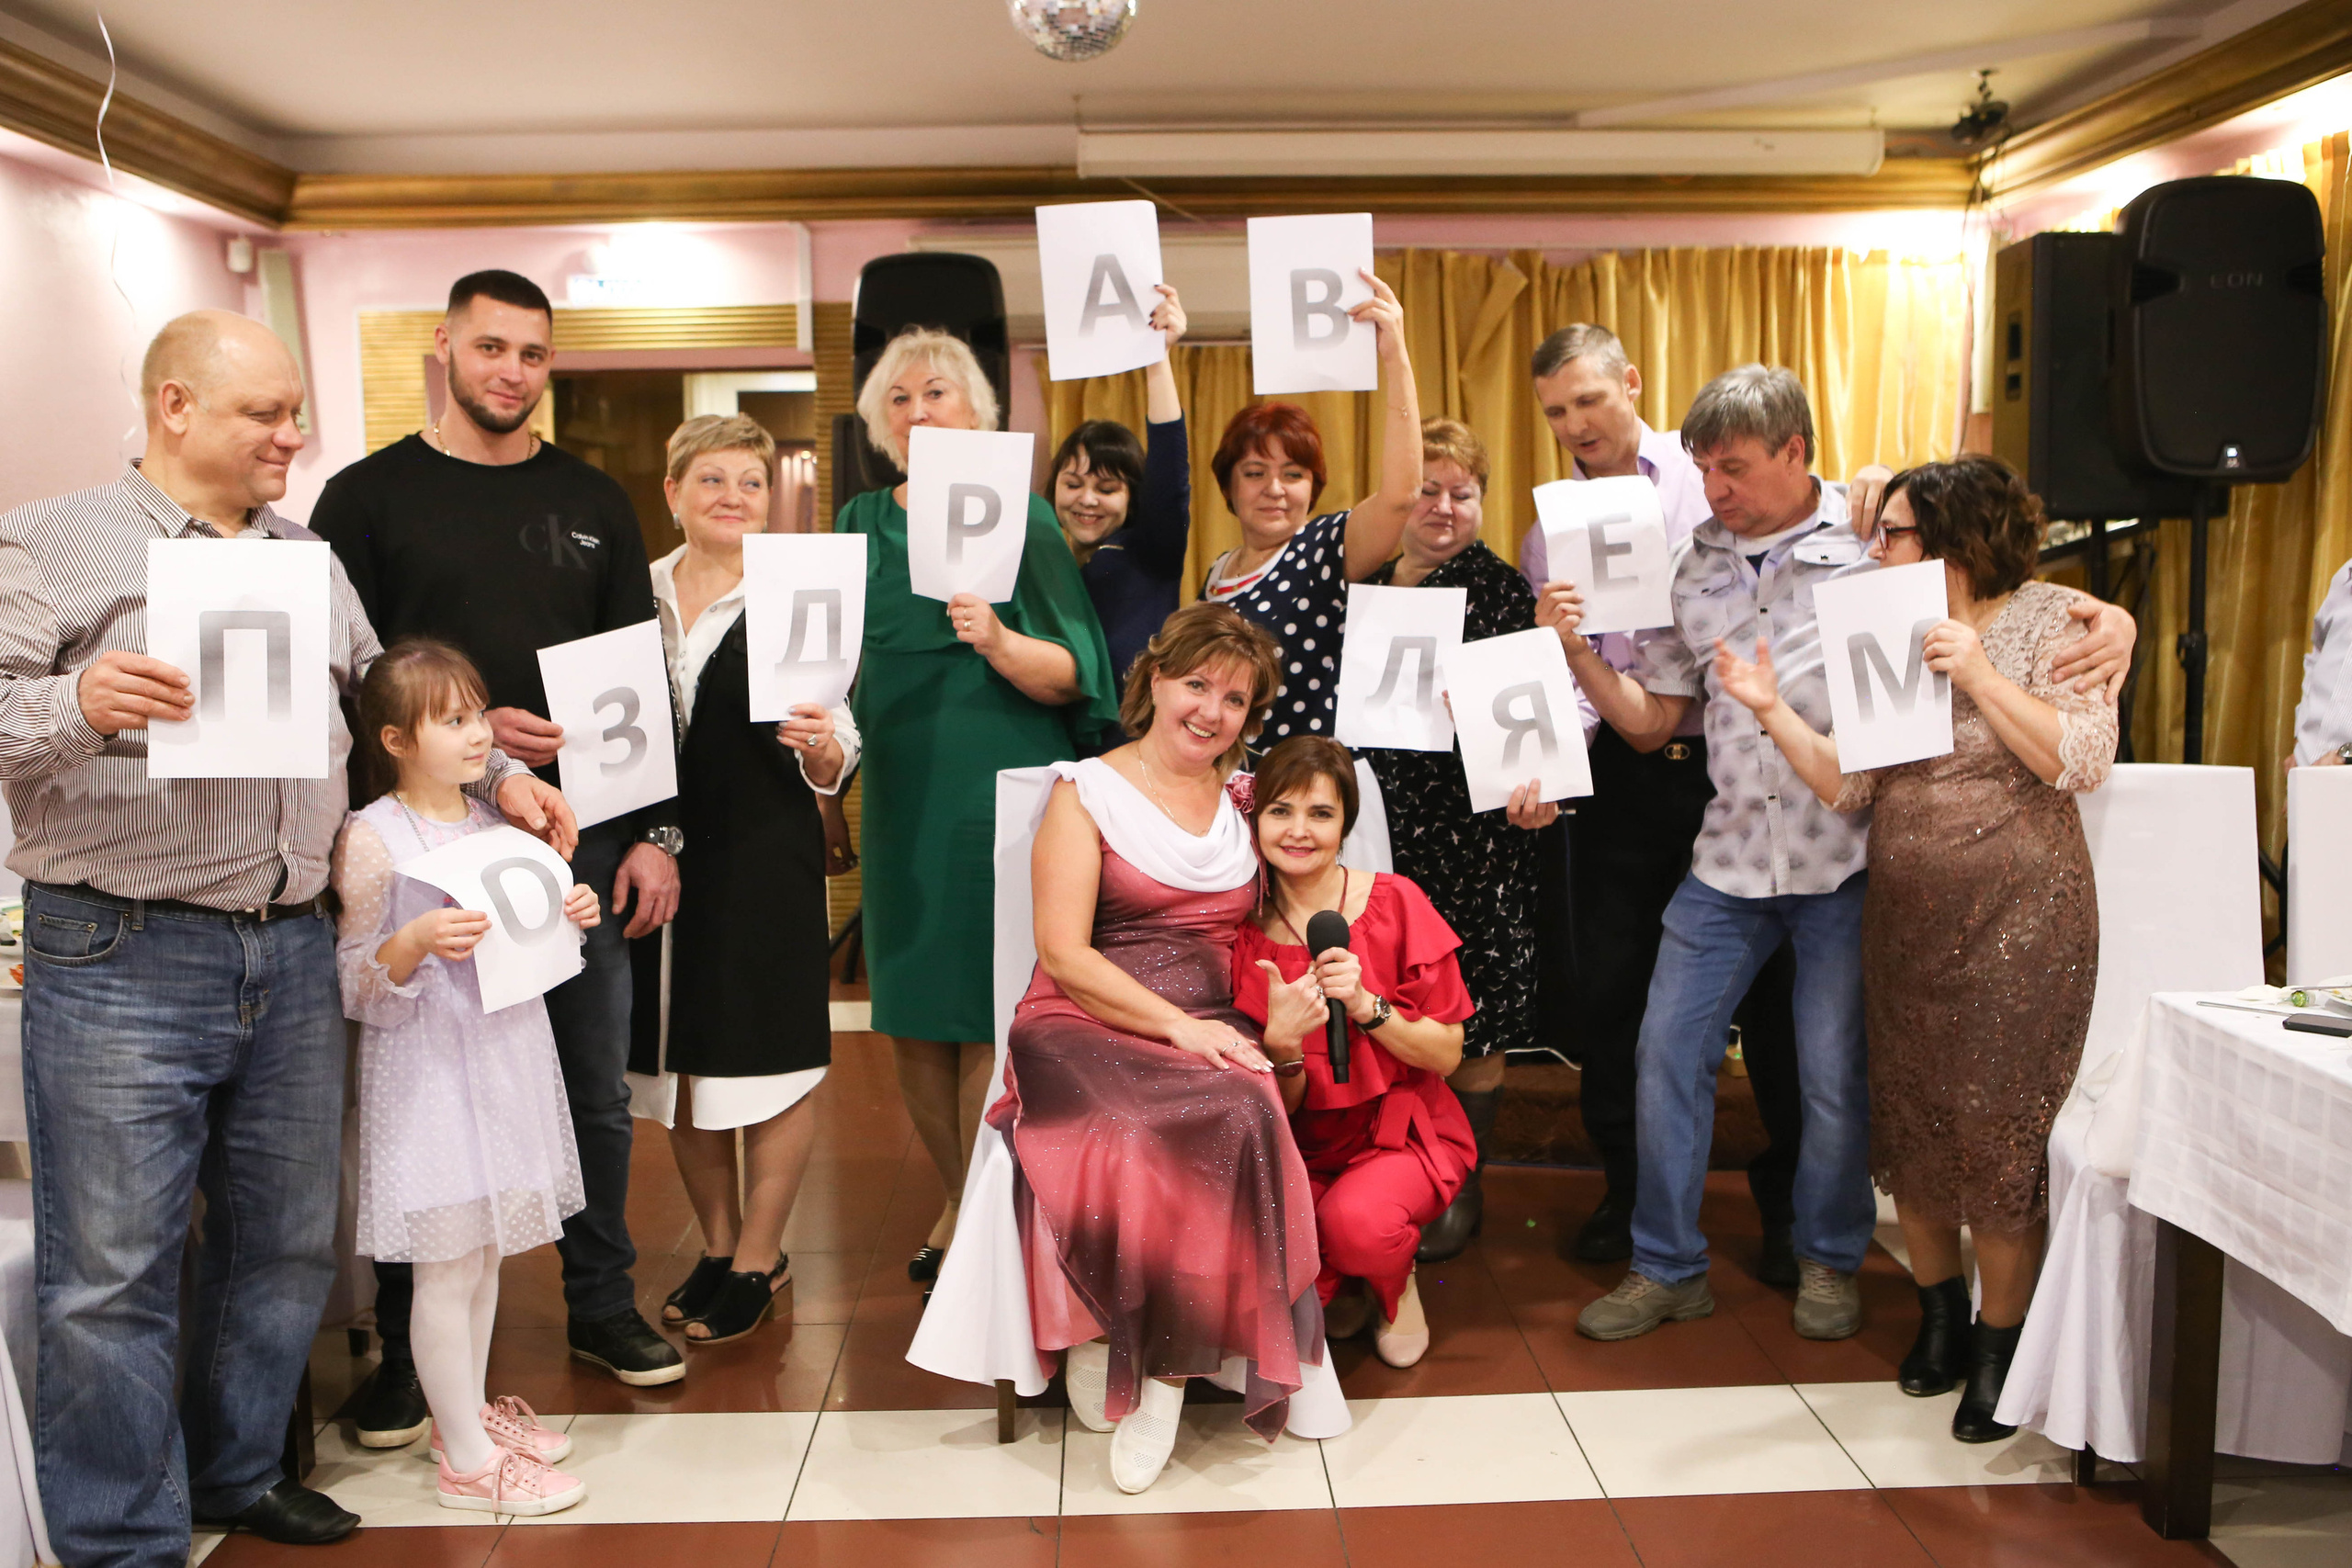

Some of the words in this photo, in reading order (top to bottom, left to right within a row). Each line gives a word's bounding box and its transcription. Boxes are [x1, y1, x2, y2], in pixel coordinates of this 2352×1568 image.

[1079, 254, 1148, 336] А
[1290, 267, 1351, 350] В
[2210, 273, 2263, 288] EON
[946, 483, 1001, 563] Р
[1587, 513, 1639, 592] Е
[199, 611, 291, 721] П
[775, 589, 847, 671] Д
[1847, 617, 1949, 724] М
[1365, 637, 1437, 710] Л
[1492, 682, 1560, 769] Я
[481, 857, 560, 946] О
